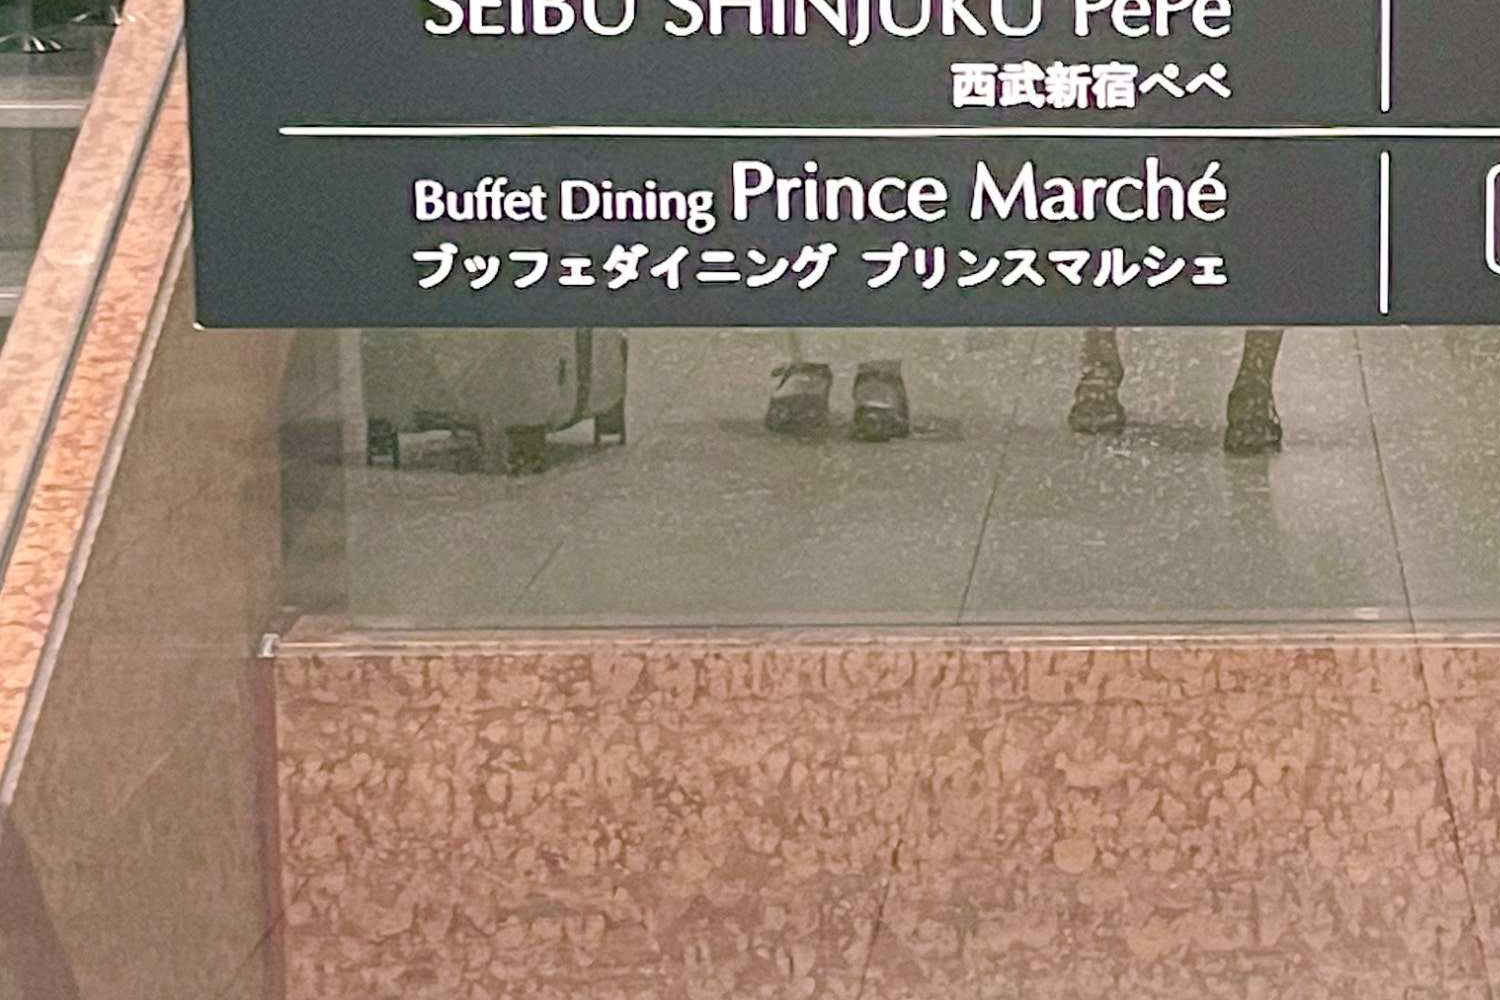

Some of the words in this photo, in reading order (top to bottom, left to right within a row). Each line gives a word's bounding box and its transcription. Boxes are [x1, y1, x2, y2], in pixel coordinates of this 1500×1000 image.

[950, 60, 1232, 109] 西武新宿ペペ
[414, 177, 548, 221] Buffet
[560, 179, 716, 235] Dining
[732, 160, 948, 222] Prince
[970, 156, 1227, 222] Marché
[413, 242, 838, 290] ブッフェダイニング
[861, 241, 1228, 290] プリンスマルシェ
